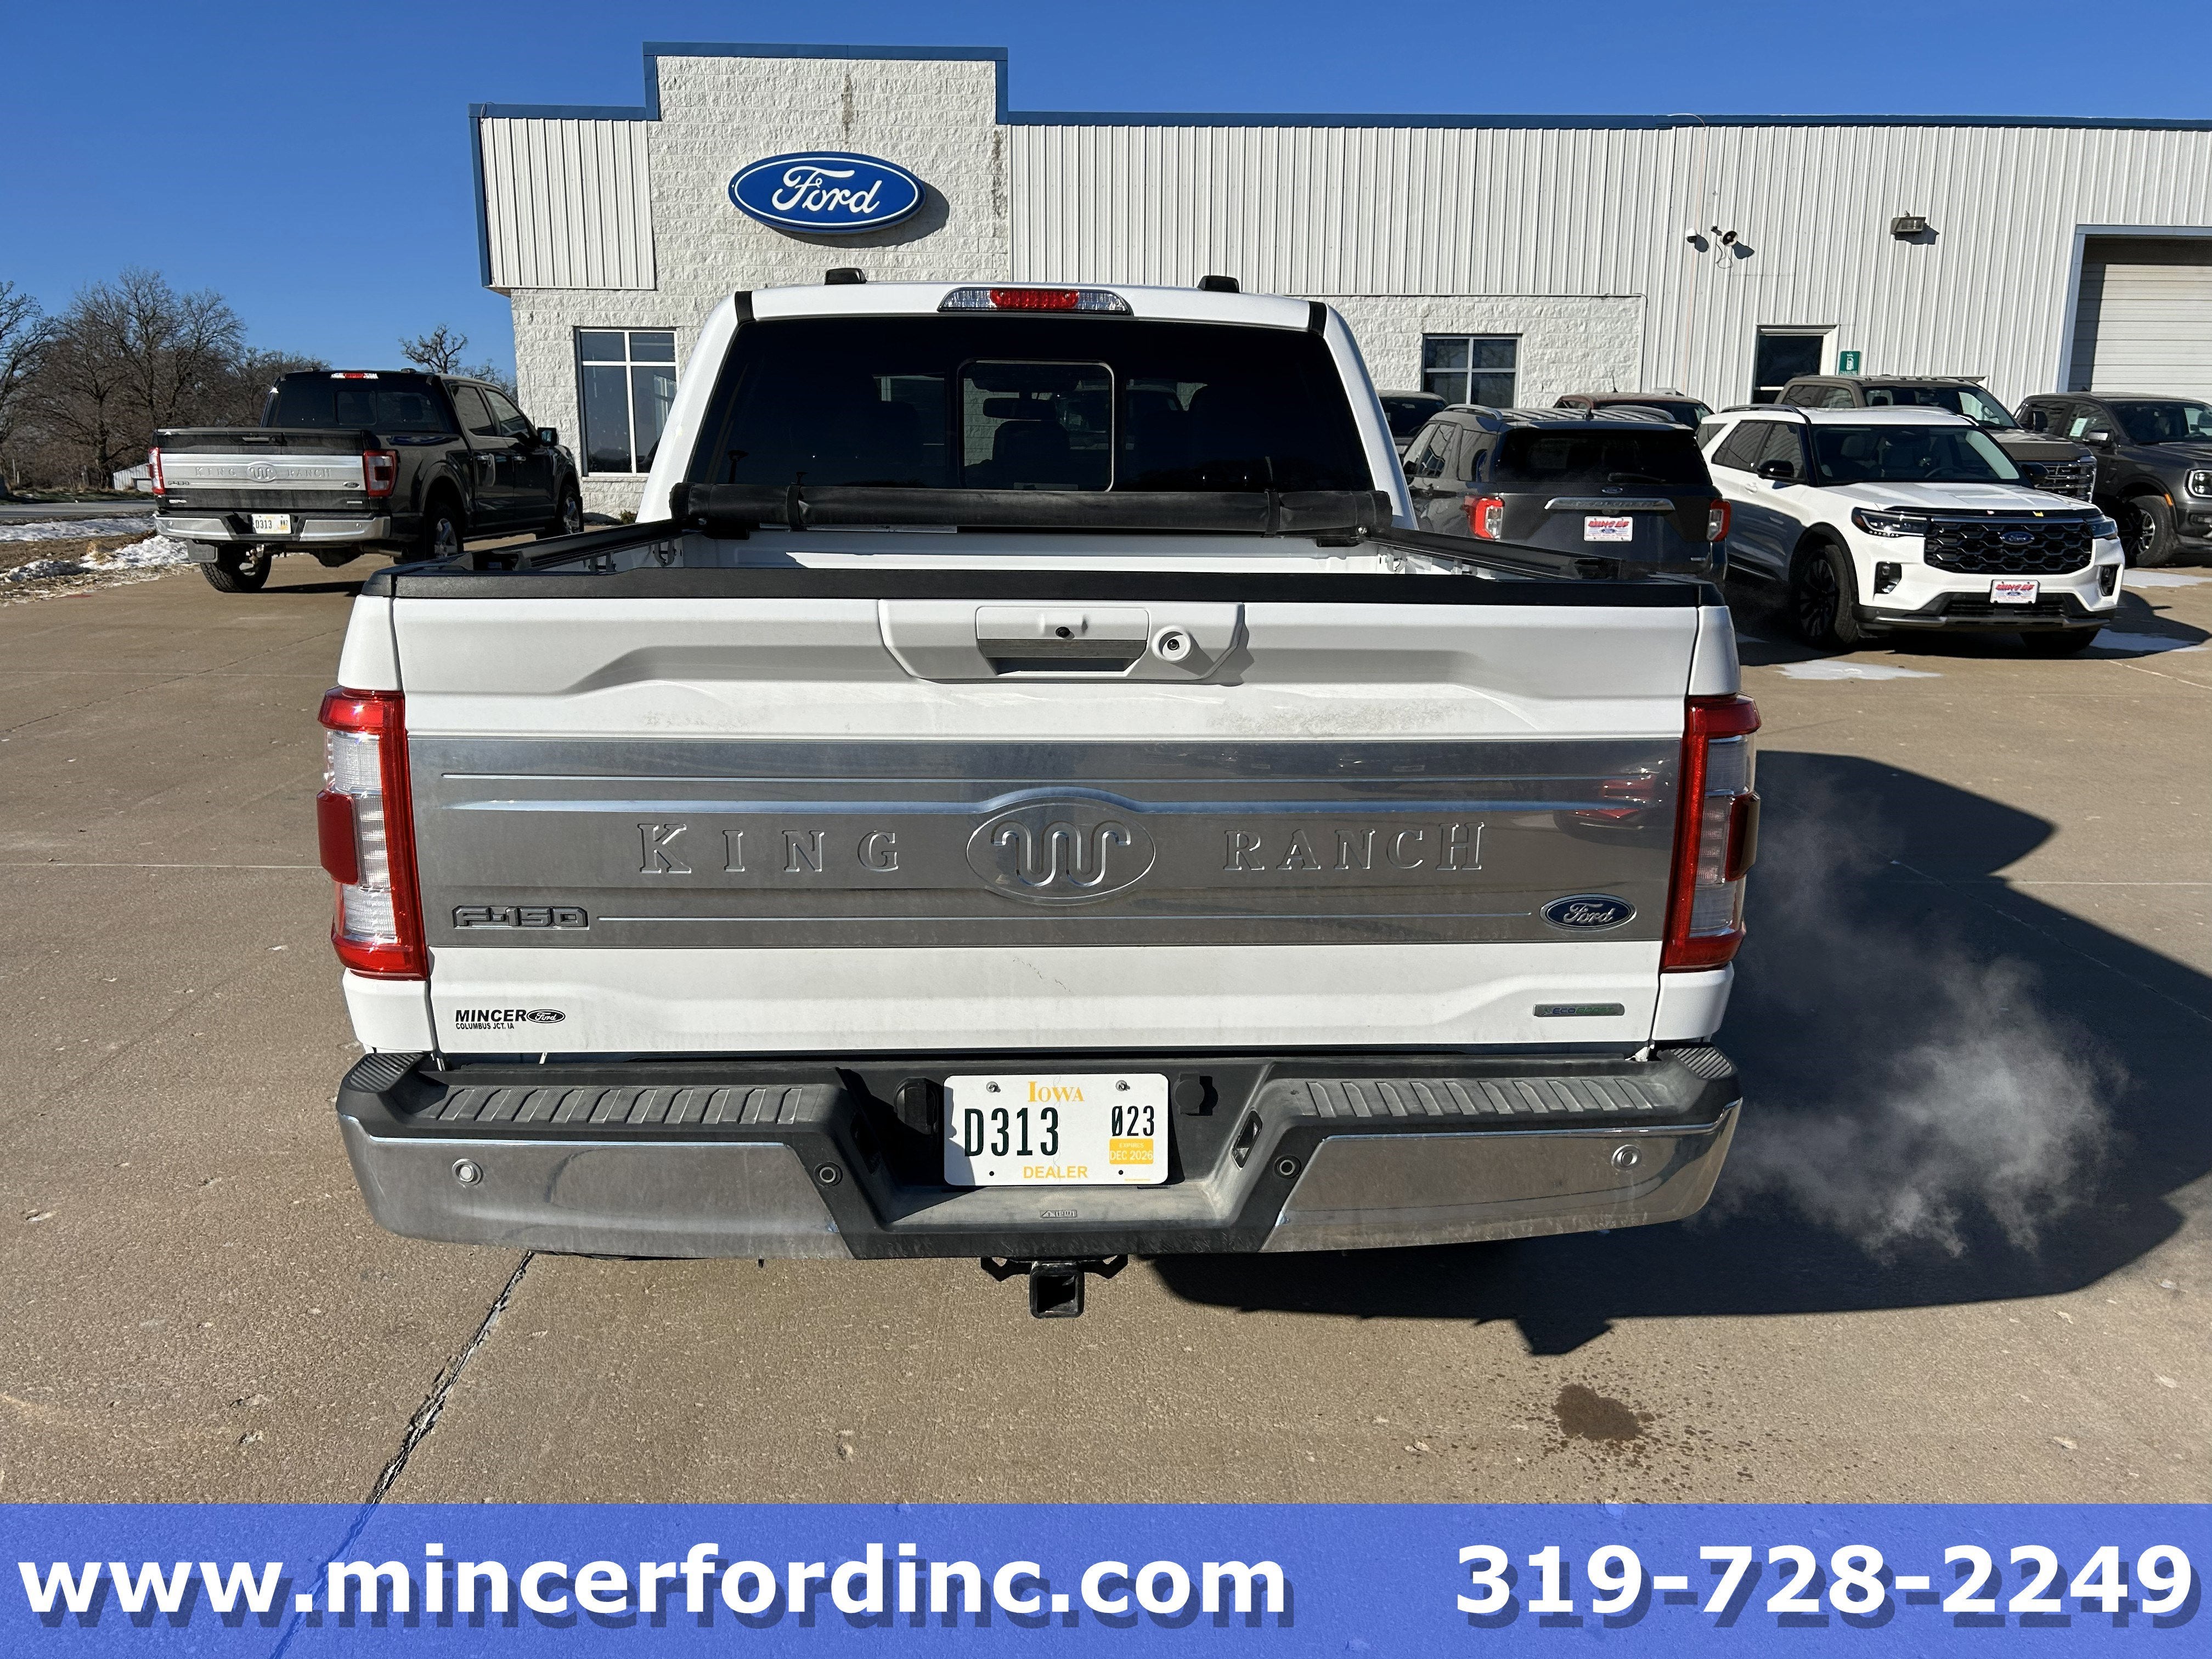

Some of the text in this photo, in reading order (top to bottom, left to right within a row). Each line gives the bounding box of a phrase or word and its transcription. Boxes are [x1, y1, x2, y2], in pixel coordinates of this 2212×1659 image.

[771, 166, 882, 213] Ford
[255, 520, 272, 529] D313
[637, 821, 1485, 874] KING RANCH
[452, 905, 590, 930] F-150
[1563, 902, 1616, 924] Ford
[455, 1009, 557, 1022] MINCER Ford
[964, 1105, 1154, 1157] D313 023
[1110, 1150, 1153, 1160] DEC 2026
[1023, 1165, 1088, 1179] DEALER
